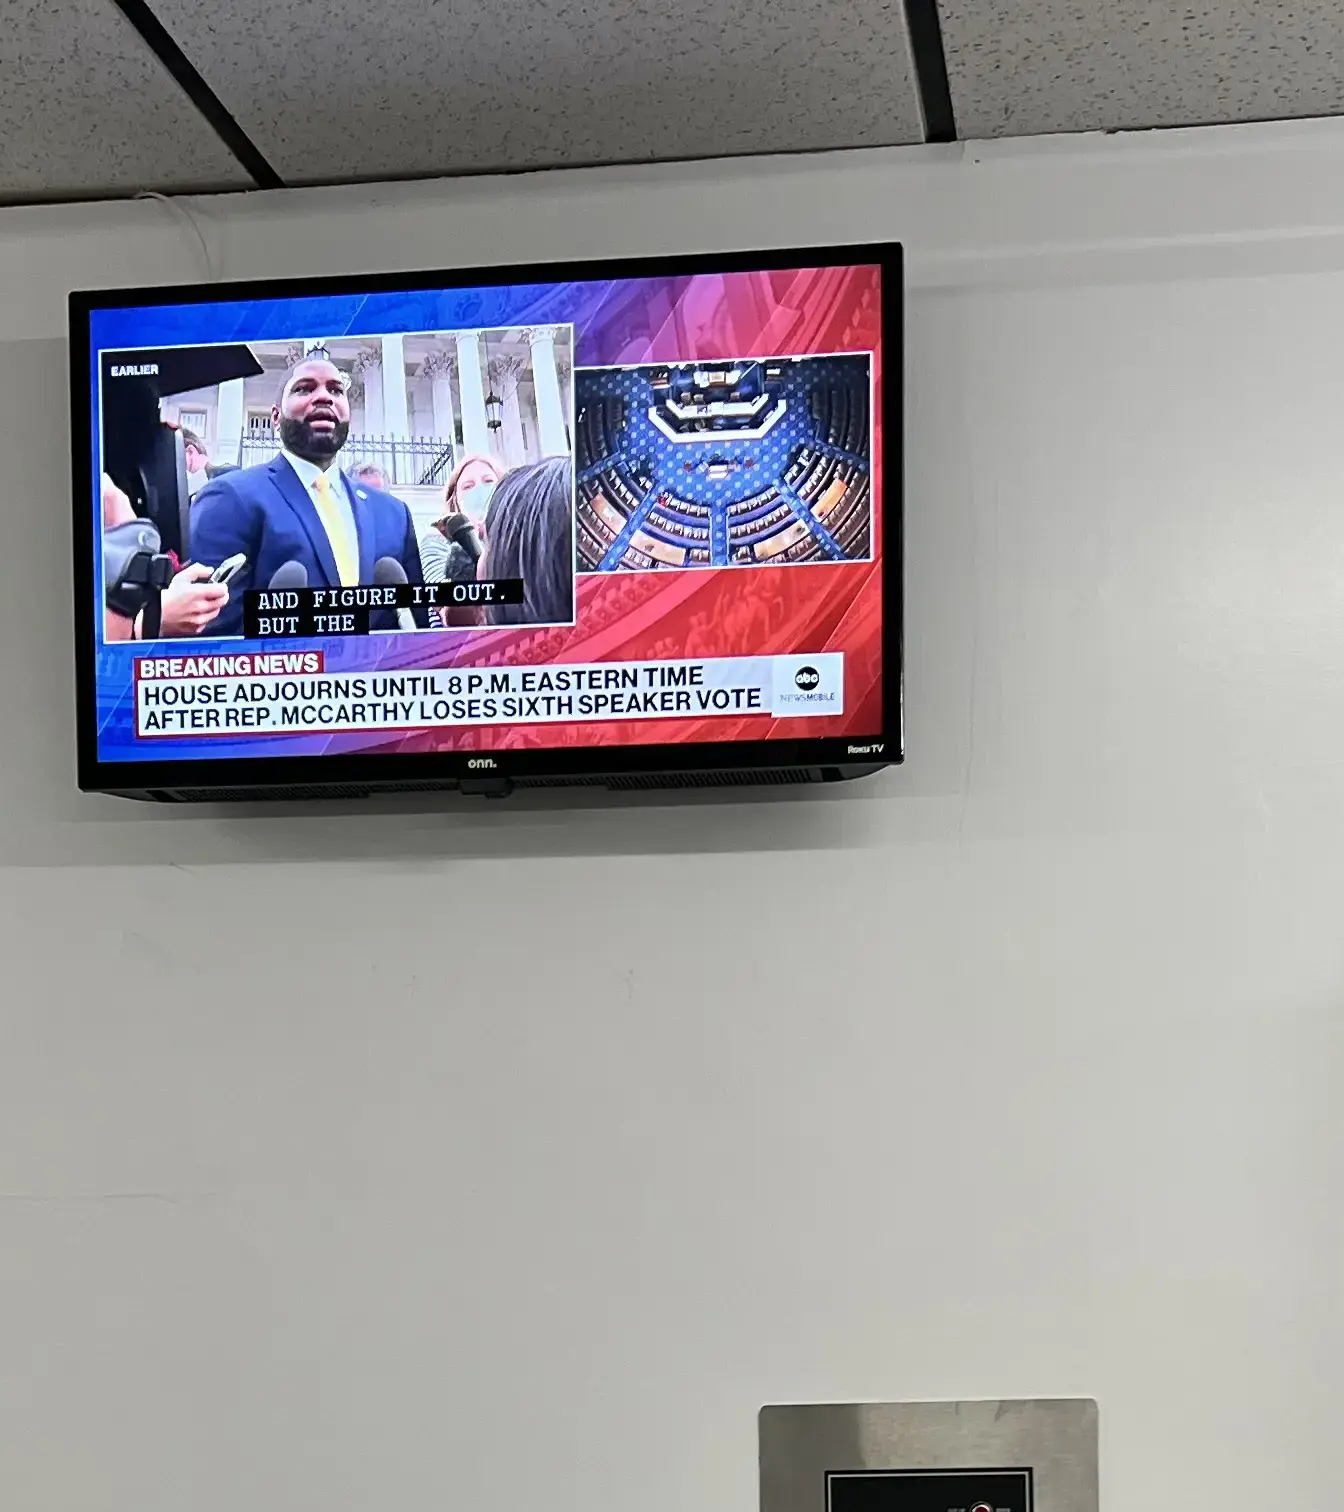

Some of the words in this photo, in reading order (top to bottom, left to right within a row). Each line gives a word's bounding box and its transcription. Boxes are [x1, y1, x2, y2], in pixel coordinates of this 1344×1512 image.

[111, 364, 159, 377] EARLIER
[258, 592, 299, 610] AND
[313, 588, 397, 608] FIGURE
[413, 586, 438, 603] IT
[453, 583, 506, 602] OUT.
[258, 616, 299, 635] BUT
[314, 614, 355, 632] THE
[140, 655, 251, 679] BREAKING
[256, 653, 319, 674] NEWS
[795, 670, 819, 685] abc
[144, 684, 228, 707] HOUSE
[233, 680, 367, 703] ADJOURNS
[372, 676, 443, 698] UNTIL
[448, 676, 462, 695] 8
[467, 674, 517, 695] P.M.
[521, 668, 639, 692] EASTERN
[643, 665, 704, 687] TIME
[144, 708, 220, 731] AFTER
[225, 707, 277, 728] REP.
[282, 701, 415, 726] MCCARTHY
[420, 698, 498, 720] LOSES
[502, 695, 573, 717] SIXTH
[578, 690, 696, 714] SPEAKER
[700, 688, 761, 710] VOTE
[871, 744, 884, 753] TV
